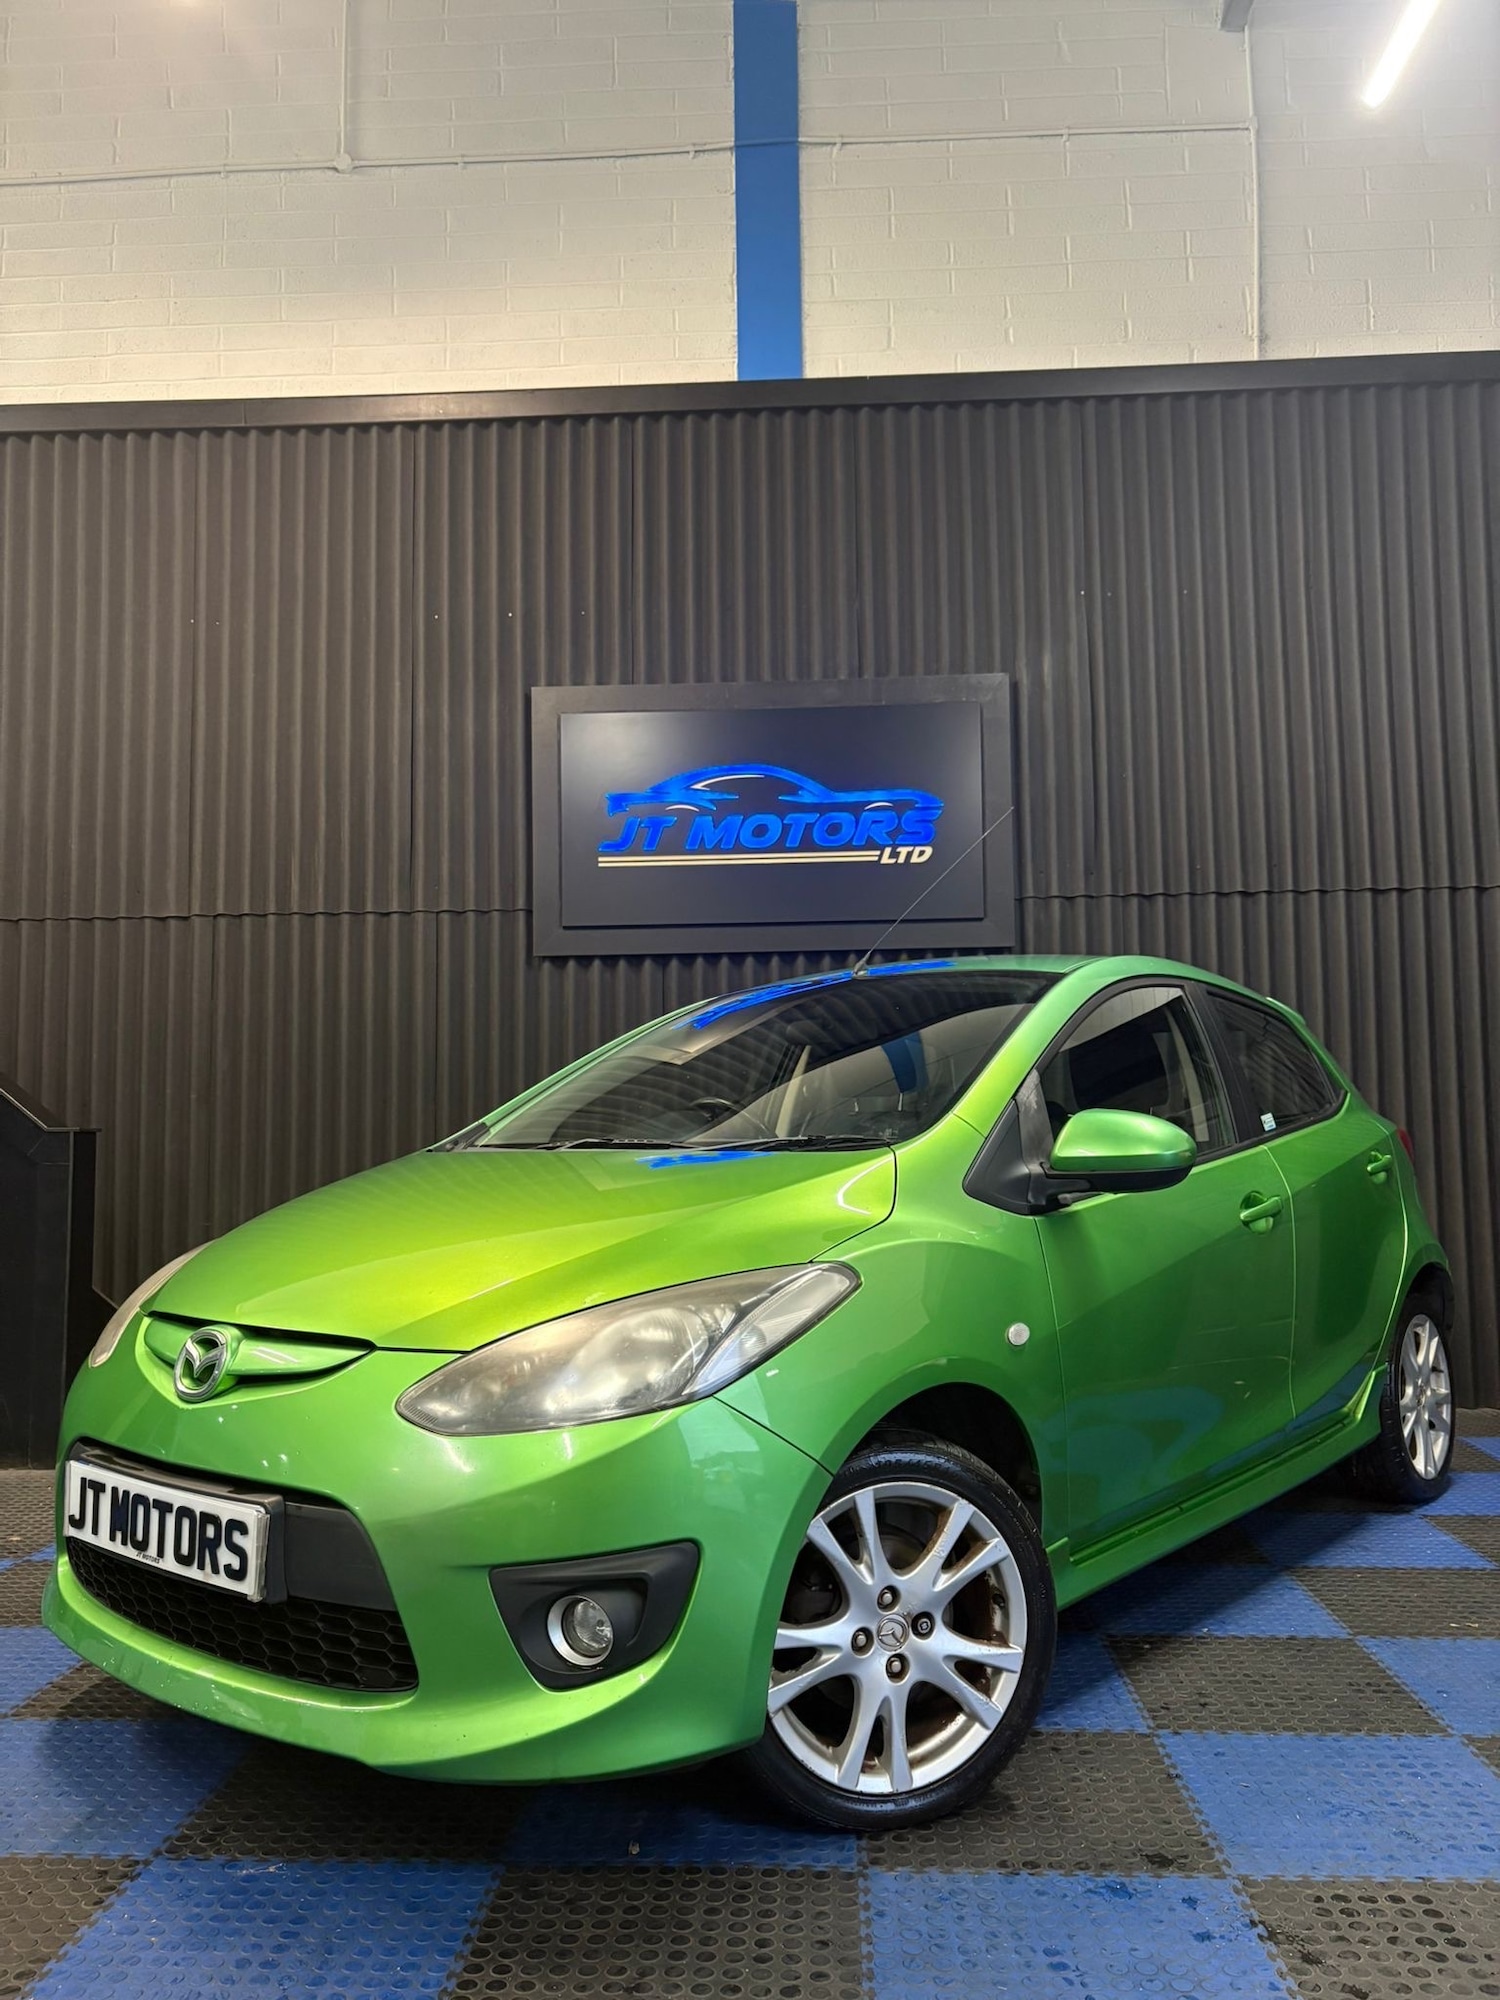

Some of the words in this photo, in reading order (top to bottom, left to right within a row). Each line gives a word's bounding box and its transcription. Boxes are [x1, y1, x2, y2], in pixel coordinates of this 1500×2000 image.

[599, 816, 677, 852] JT
[685, 809, 943, 849] MOTORS
[880, 846, 933, 865] LTD
[68, 1477, 106, 1536] JT
[109, 1486, 249, 1581] MOTORS
